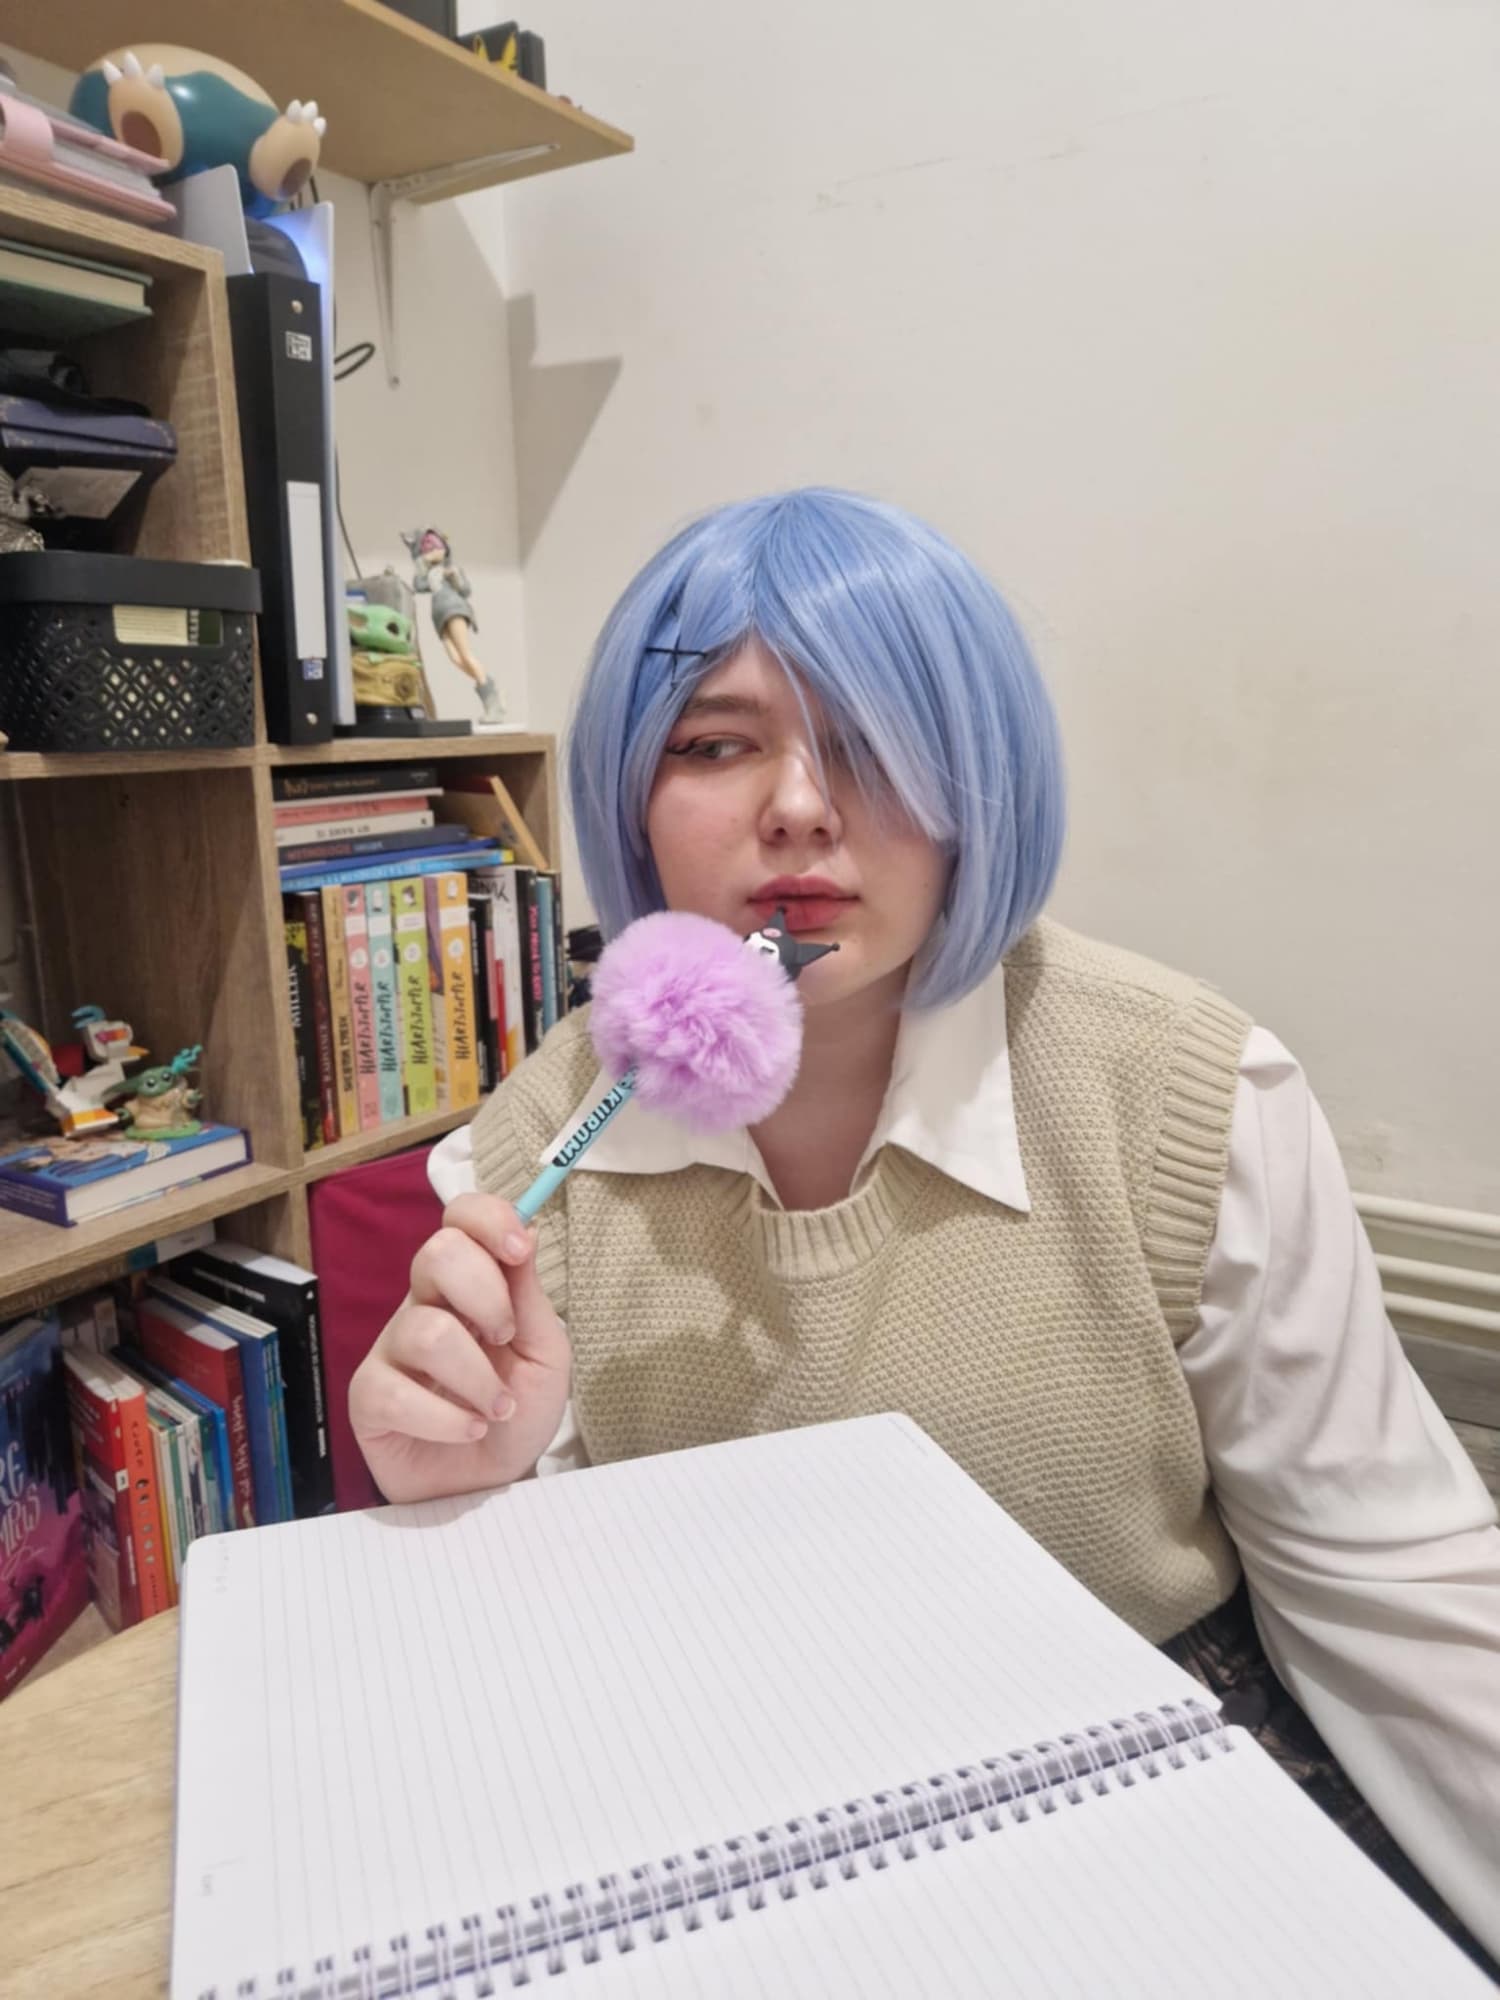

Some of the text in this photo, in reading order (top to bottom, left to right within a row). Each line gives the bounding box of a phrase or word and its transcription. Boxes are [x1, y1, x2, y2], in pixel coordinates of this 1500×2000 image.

[358, 982, 377, 1074] HEARTSTOPPER
[377, 981, 397, 1072] HEARTSTOPPER
[408, 975, 428, 1064] HEARTSTOPPER
[452, 971, 470, 1061] HEARTSTOPPER
